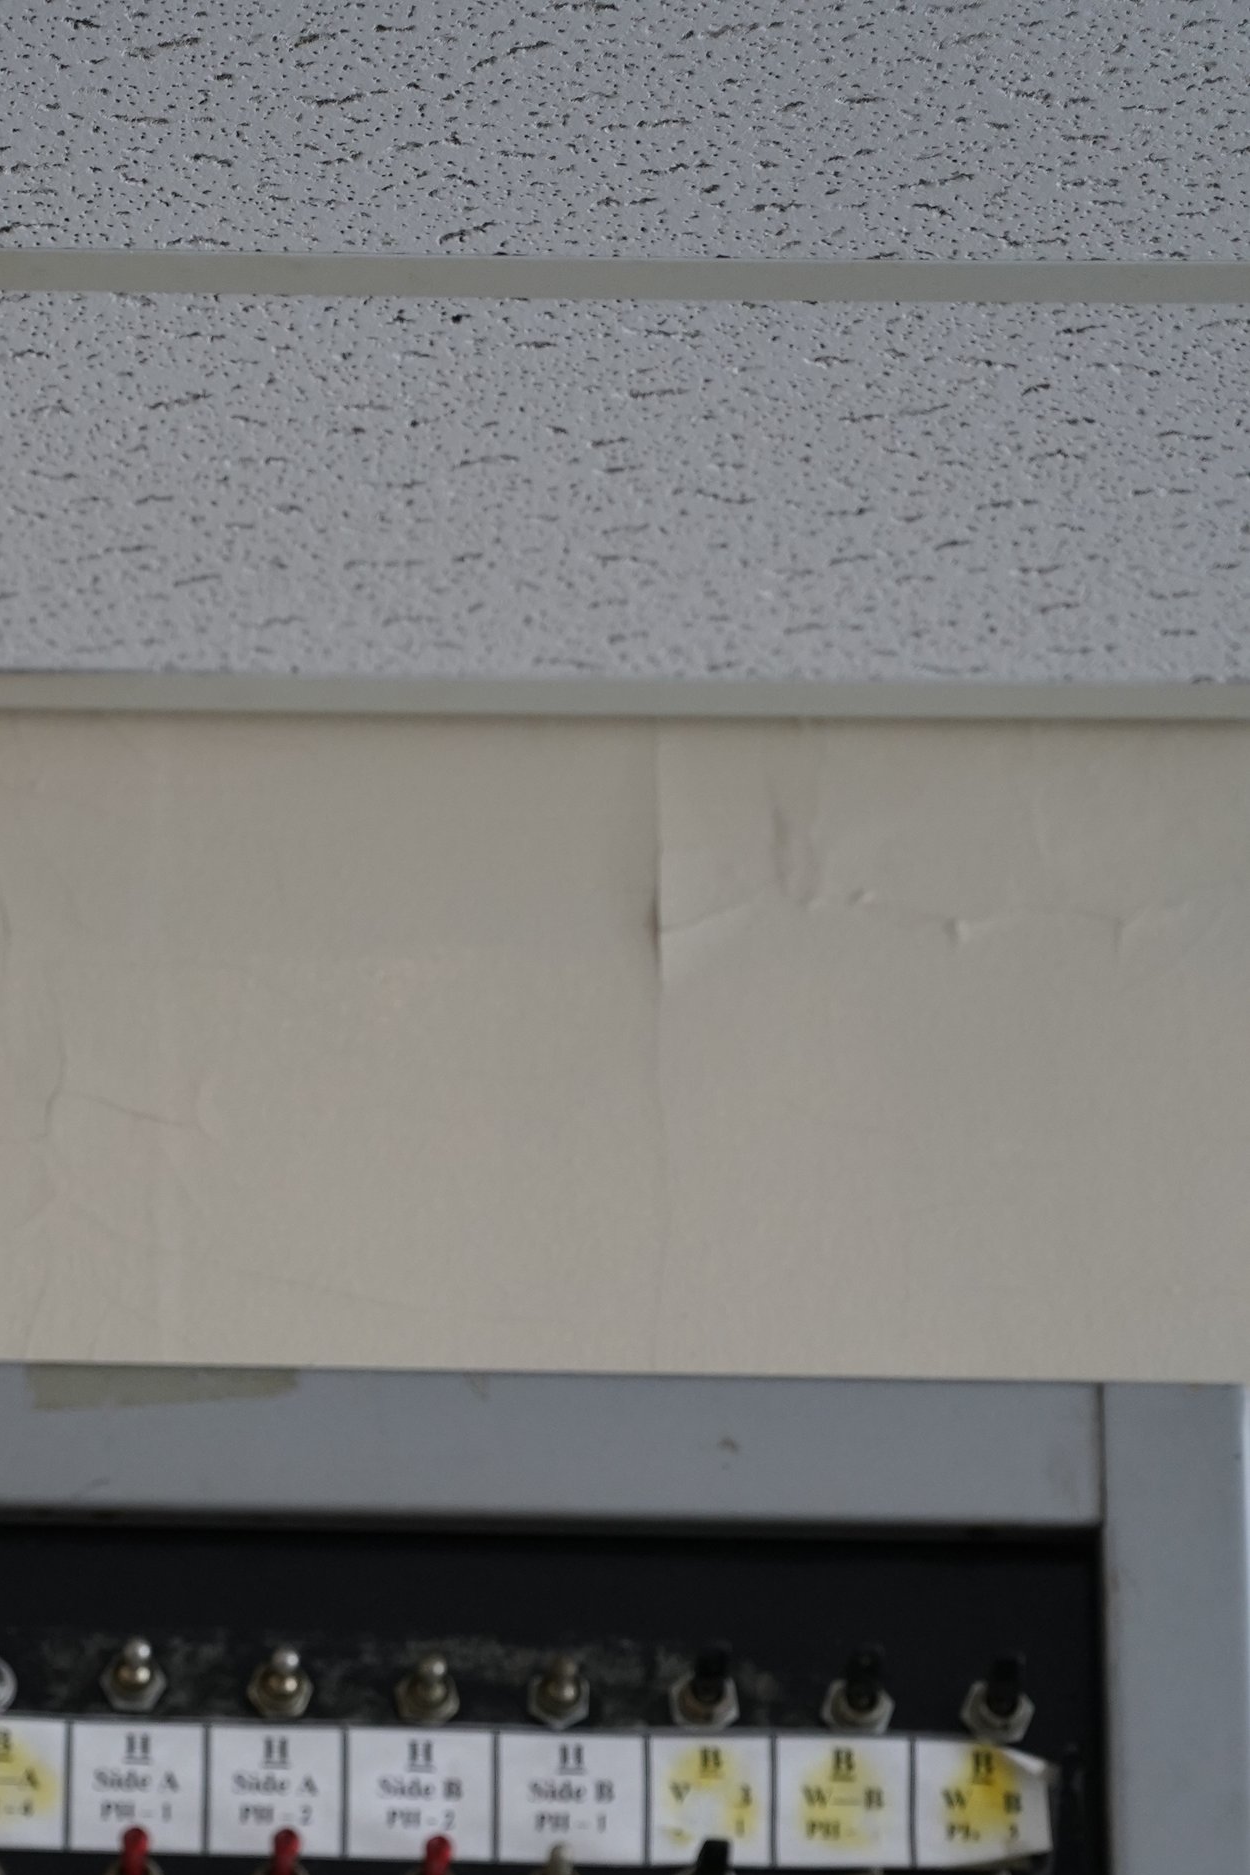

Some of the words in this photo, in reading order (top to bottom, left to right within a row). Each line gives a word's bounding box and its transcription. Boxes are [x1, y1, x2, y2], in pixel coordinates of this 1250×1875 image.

[125, 1733, 151, 1764] H
[263, 1738, 289, 1768] H
[407, 1740, 433, 1770] H
[558, 1744, 585, 1774] H
[833, 1750, 855, 1779] B
[92, 1769, 151, 1793] Side
[159, 1770, 179, 1792] A
[232, 1773, 290, 1798] Side
[297, 1775, 319, 1797] A
[378, 1778, 434, 1802] Side
[444, 1779, 462, 1801] B
[528, 1781, 585, 1805] Side
[595, 1782, 614, 1804] B
